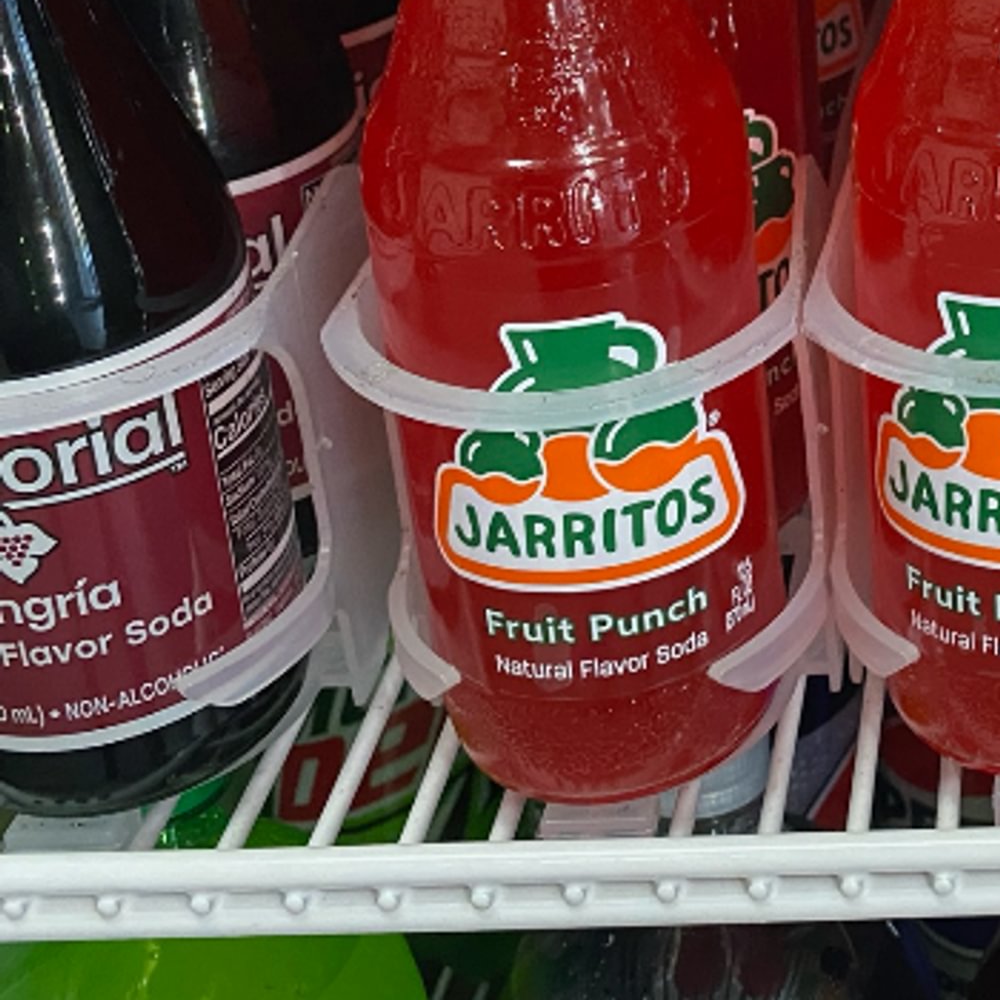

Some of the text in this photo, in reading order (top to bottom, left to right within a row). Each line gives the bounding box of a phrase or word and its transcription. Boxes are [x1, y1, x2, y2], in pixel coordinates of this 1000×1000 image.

[454, 474, 717, 559] JARRITOS
[484, 607, 577, 644] Fruit
[588, 586, 709, 642] Punch
[905, 562, 982, 617] Fruit
[0, 633, 113, 668] Flavor
[124, 591, 214, 645] Soda
[494, 630, 710, 680] Natural Flavor Soda
[909, 608, 976, 651] Natural
